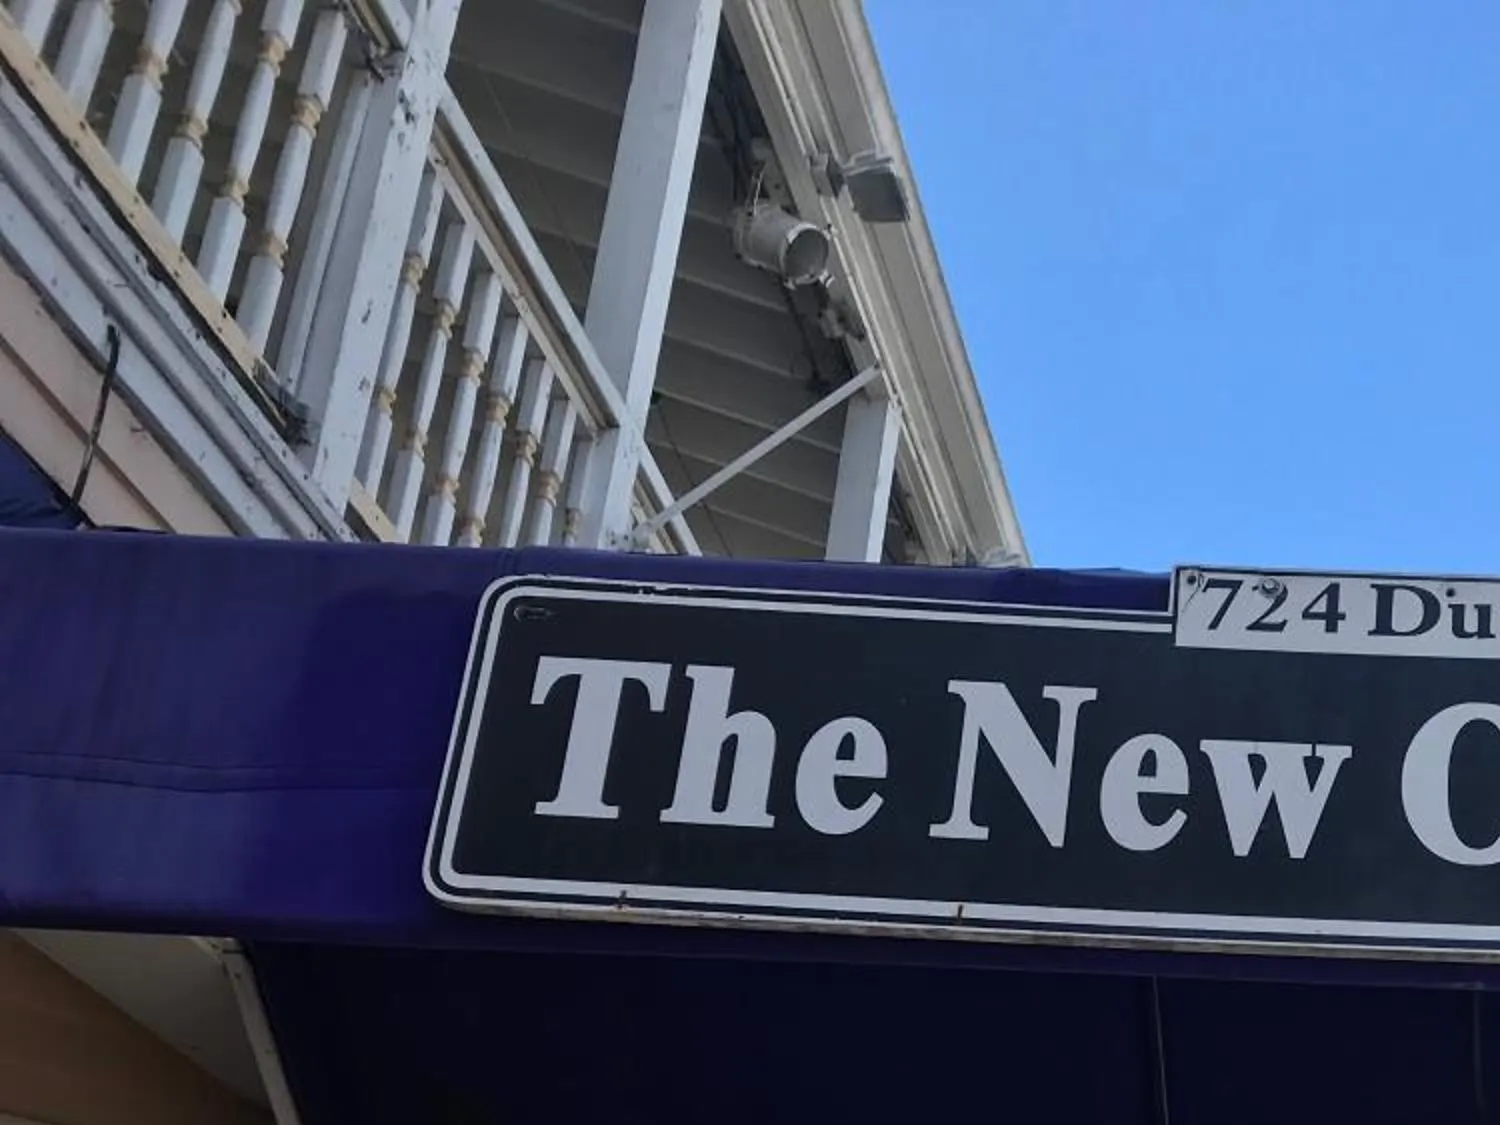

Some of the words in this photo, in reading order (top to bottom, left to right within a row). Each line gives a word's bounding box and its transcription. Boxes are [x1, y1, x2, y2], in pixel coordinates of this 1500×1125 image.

[1201, 577, 1347, 634] 724
[530, 655, 887, 835] The
[929, 679, 1353, 859] New
